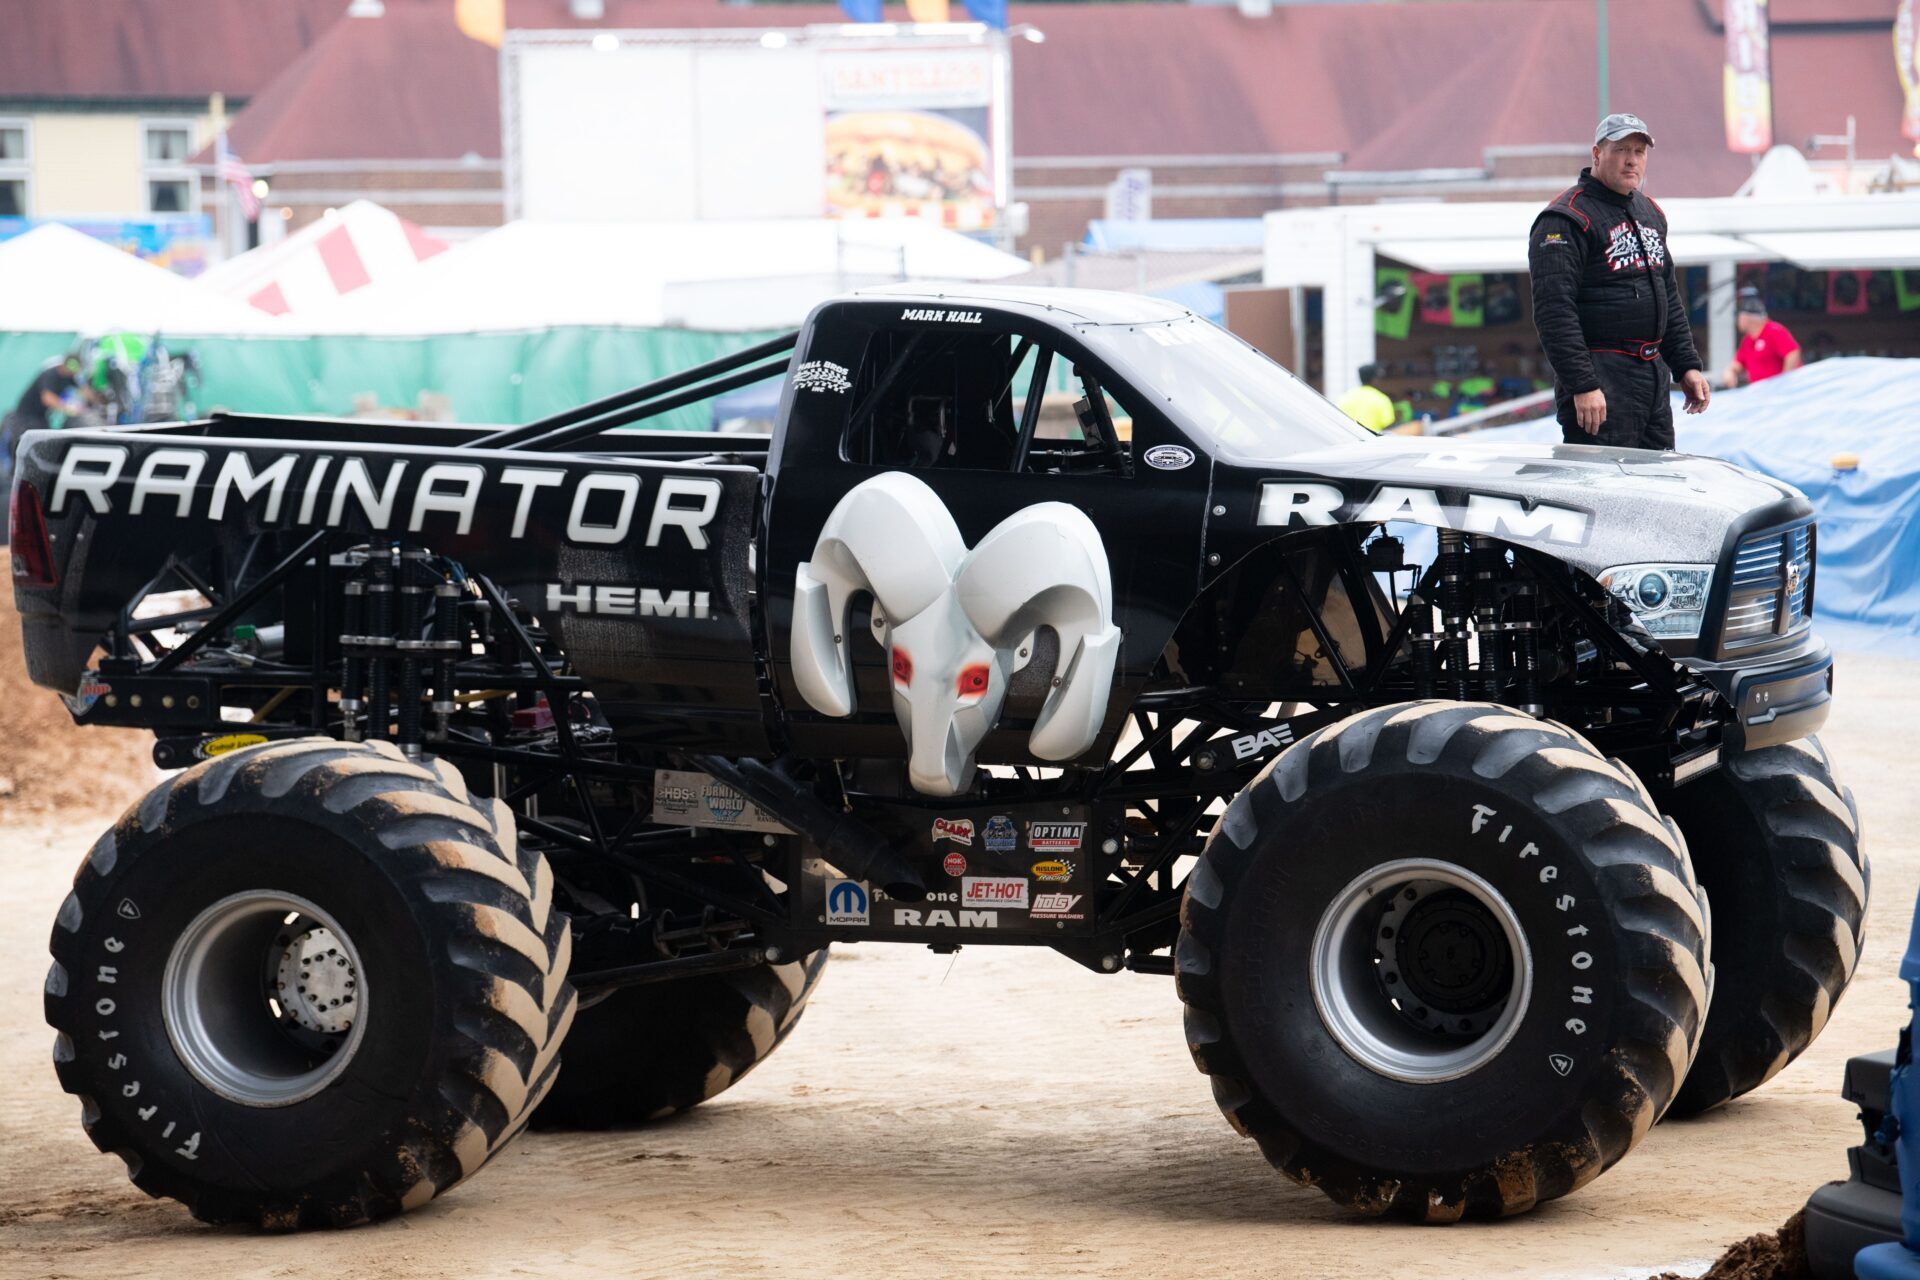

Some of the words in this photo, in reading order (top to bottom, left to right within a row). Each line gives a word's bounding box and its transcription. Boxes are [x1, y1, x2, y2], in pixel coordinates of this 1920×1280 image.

[901, 309, 946, 322] MARK
[945, 311, 983, 324] HALL
[797, 361, 821, 372] HALL
[823, 361, 849, 375] BROS
[50, 445, 722, 550] RAMINATOR
[1257, 482, 1590, 544] RAM
[546, 583, 711, 619] HEMI
[1231, 723, 1294, 759] BAE
[709, 797, 743, 811] WORLD
[935, 819, 971, 839] CLARK
[1034, 826, 1079, 838] OPTIMA
[967, 883, 1024, 899] JET-HOT
[894, 908, 998, 928] RAM
[1472, 804, 1593, 1035] Firestone
[96, 937, 201, 1161] Firestone
